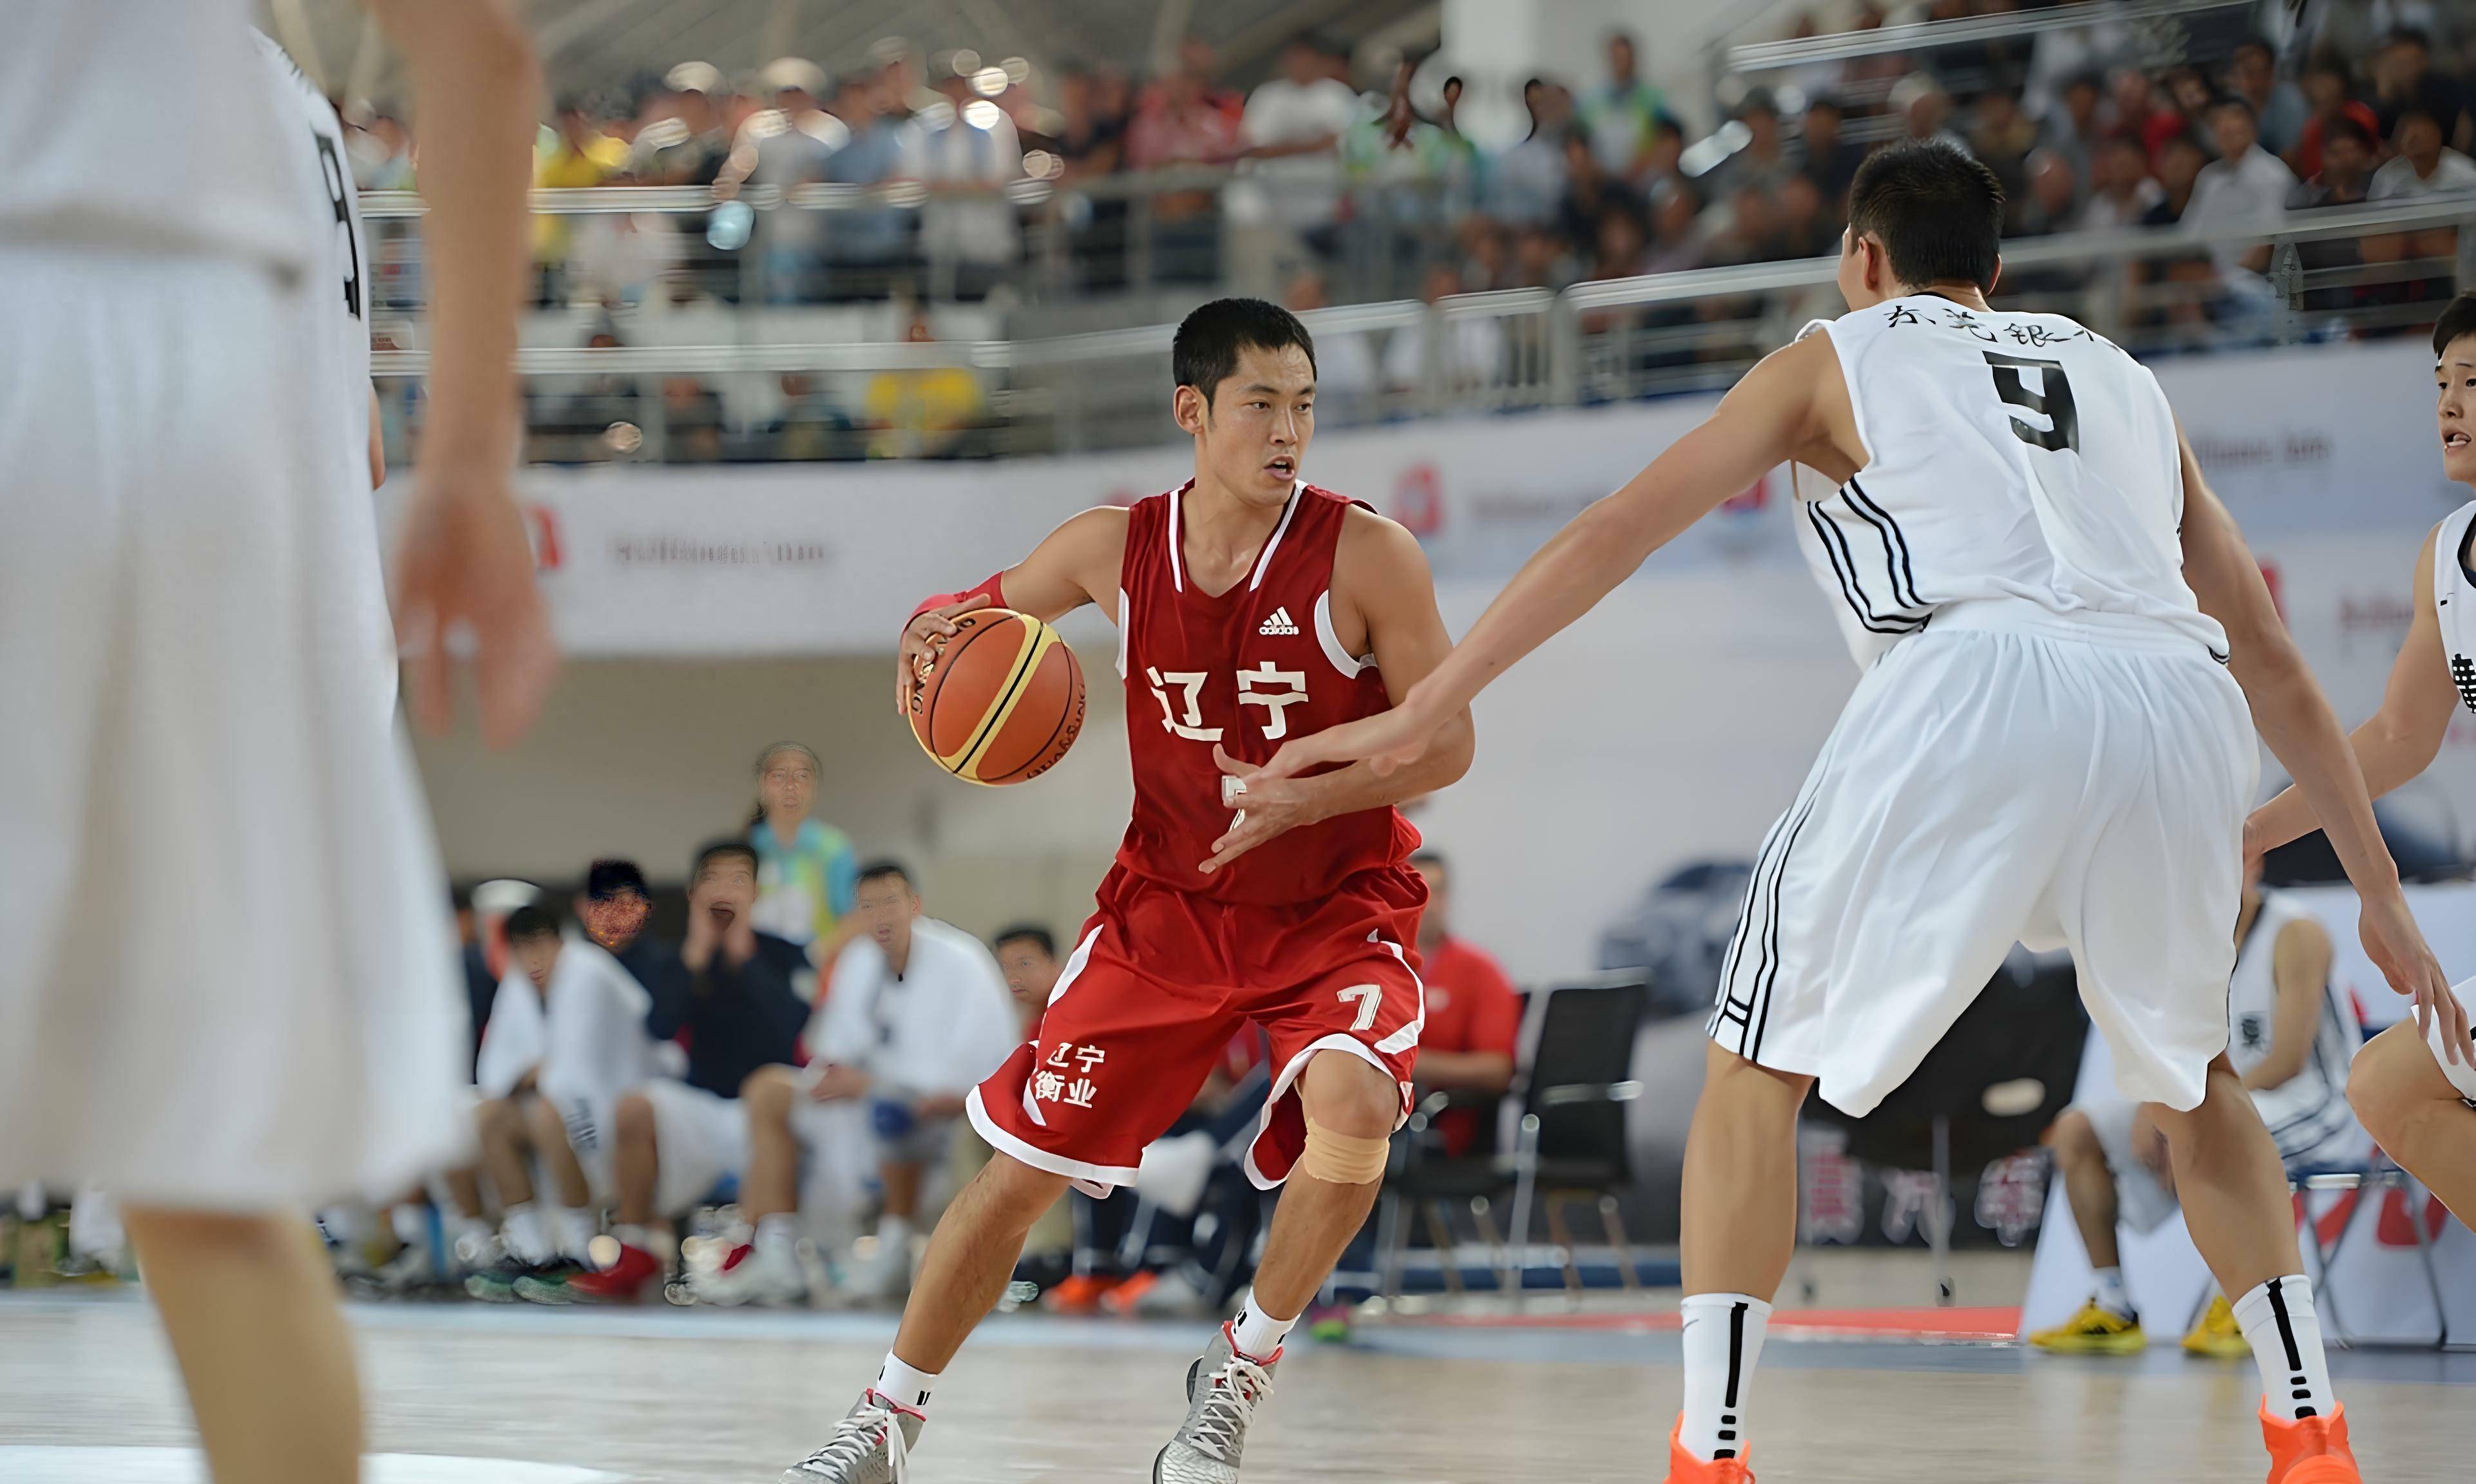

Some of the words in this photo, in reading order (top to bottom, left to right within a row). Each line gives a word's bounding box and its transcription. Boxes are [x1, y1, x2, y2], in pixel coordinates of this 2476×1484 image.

[1982, 350, 2081, 456] 9
[1146, 661, 1309, 741] 辽宁
[1336, 984, 1383, 1031] 7
[1045, 1042, 1105, 1073] 辽宁
[1034, 1070, 1098, 1108] 衡业
